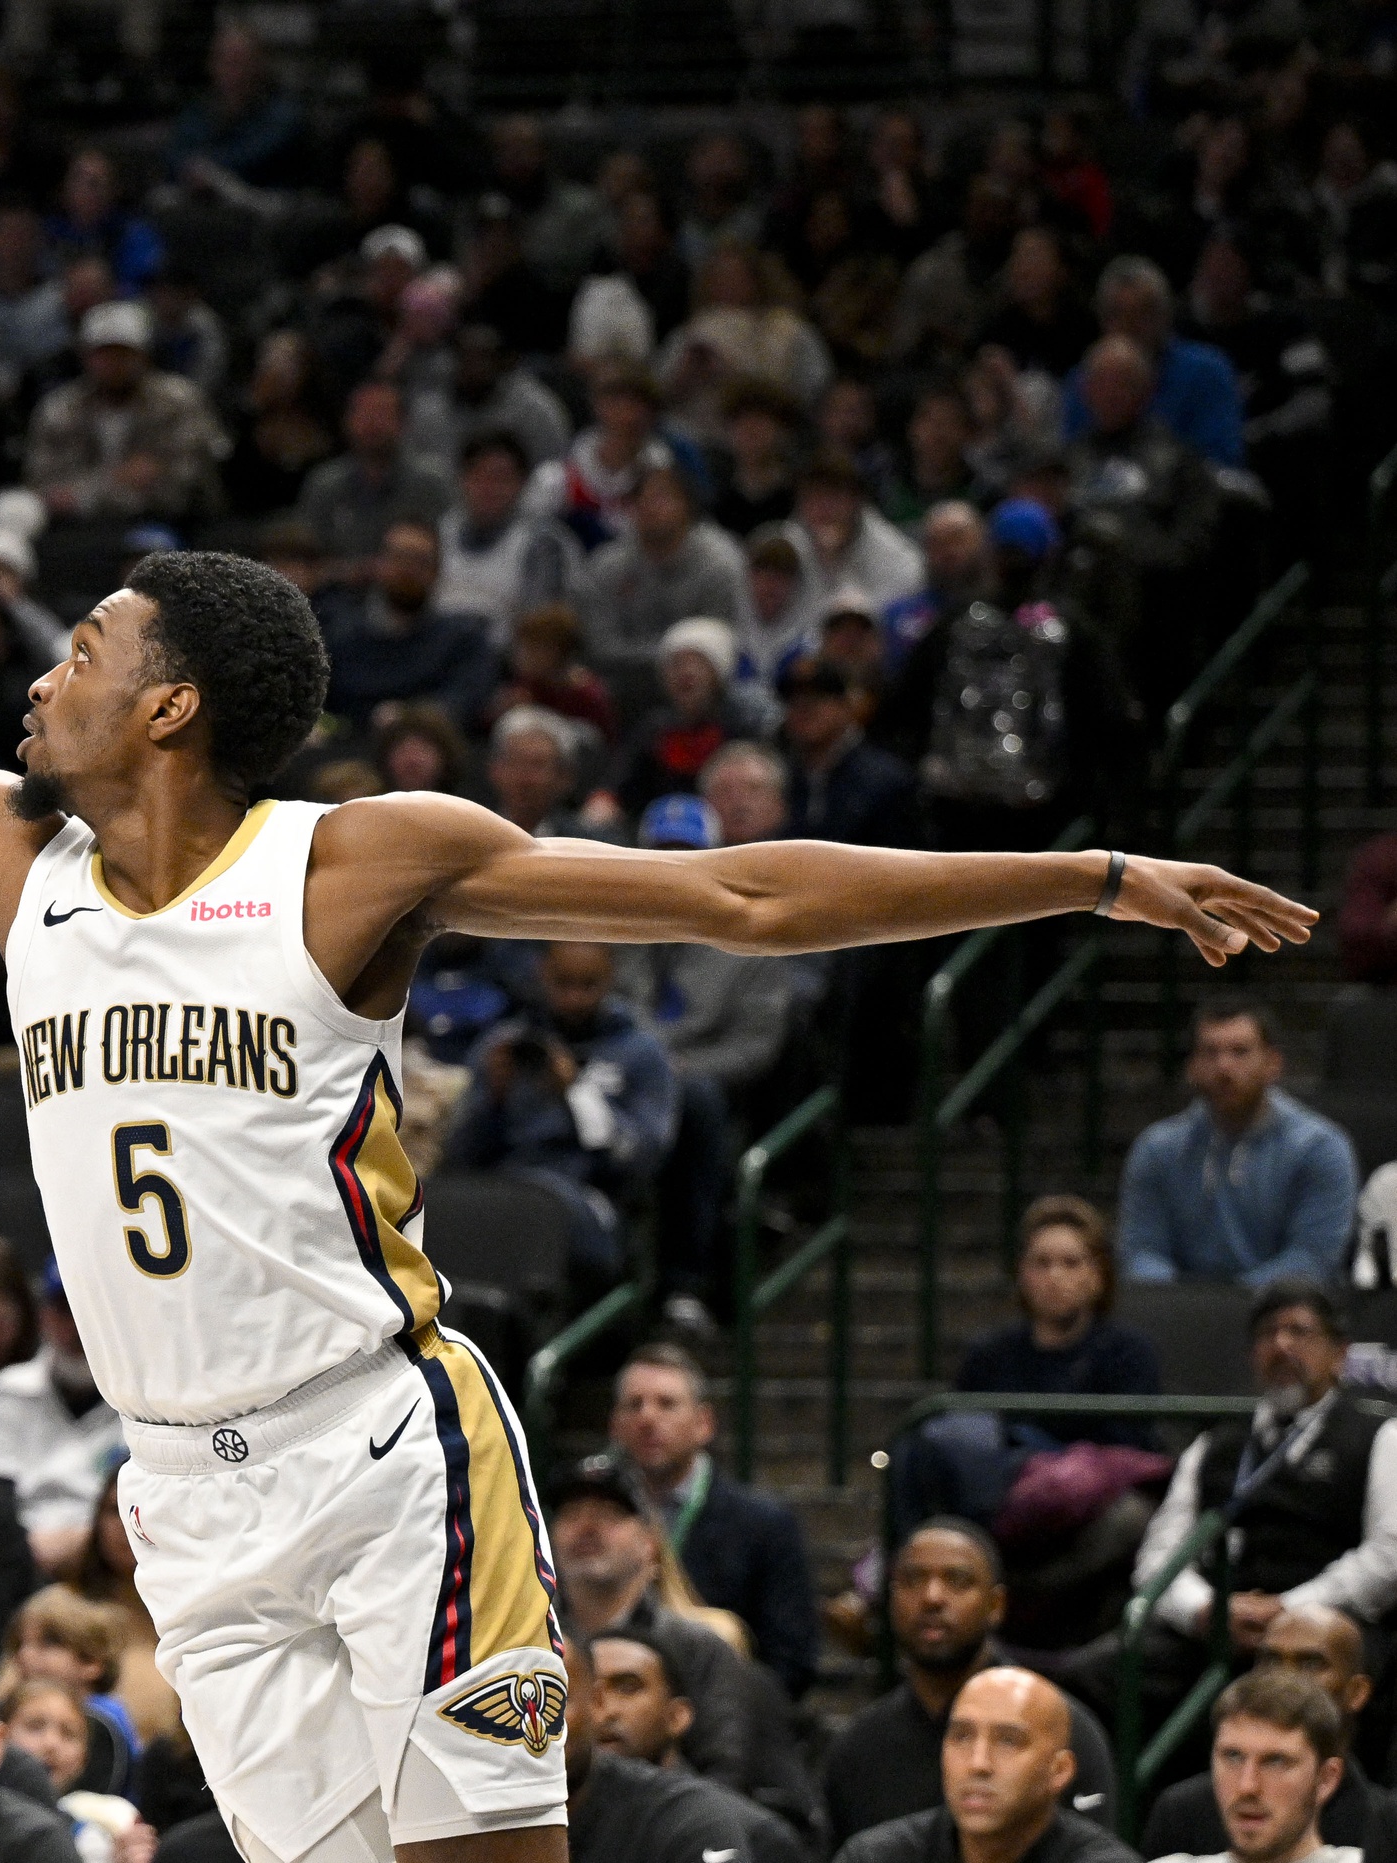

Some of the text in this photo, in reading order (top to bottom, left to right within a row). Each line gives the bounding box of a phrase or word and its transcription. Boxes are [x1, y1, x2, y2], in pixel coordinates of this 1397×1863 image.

[190, 900, 272, 922] ibotta
[21, 1002, 299, 1111] NEW ORLEANS
[110, 1119, 193, 1281] 5
